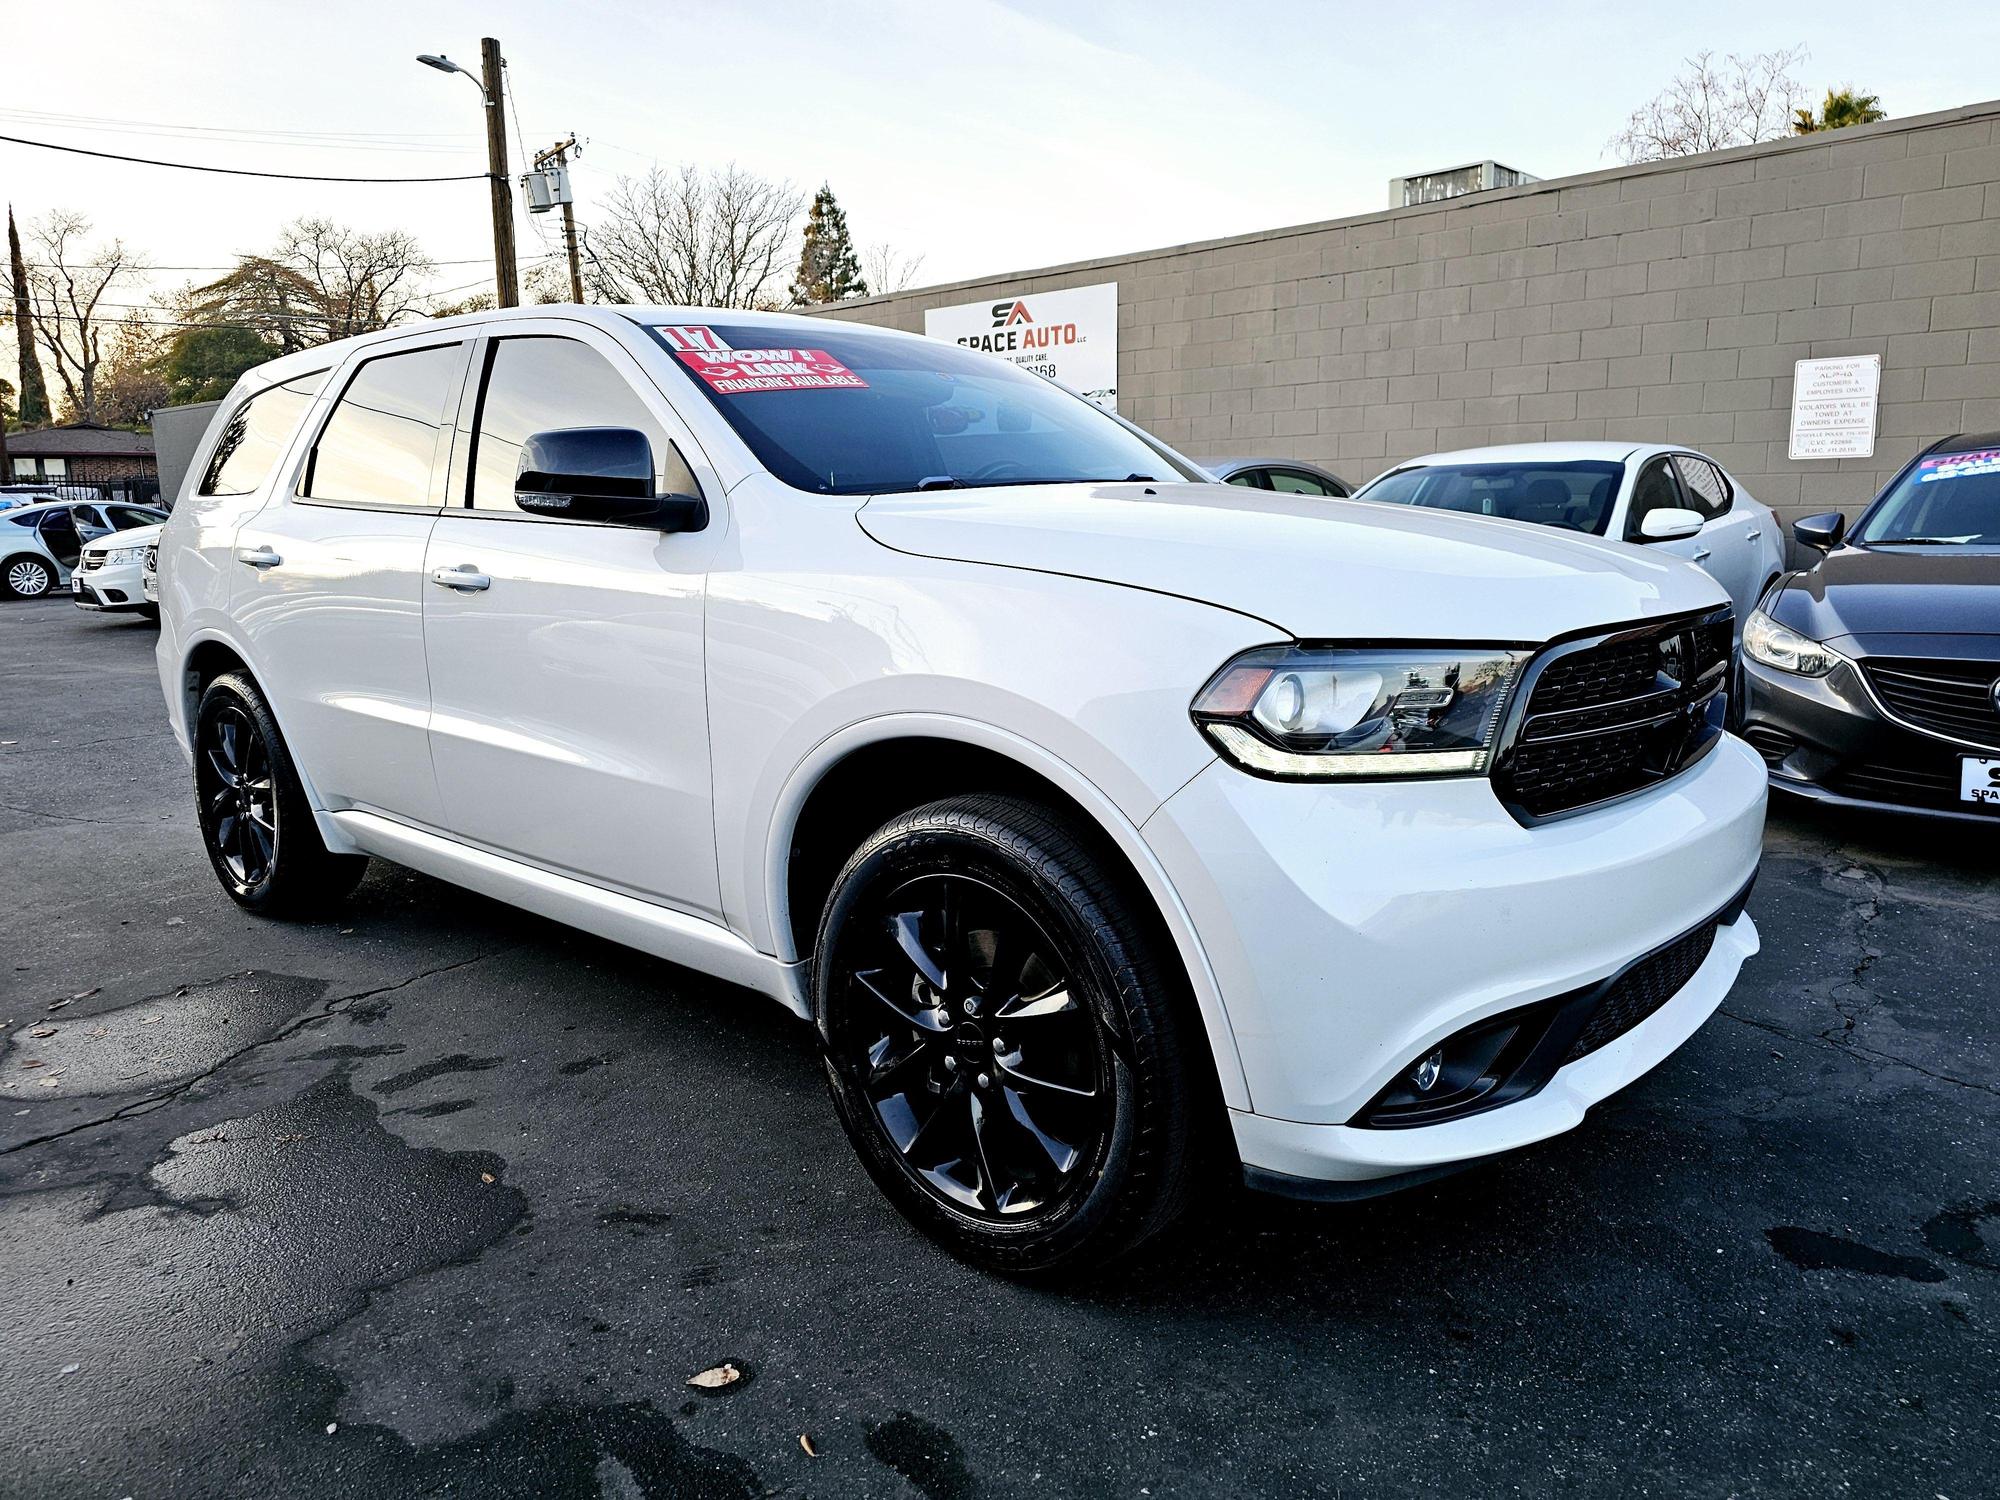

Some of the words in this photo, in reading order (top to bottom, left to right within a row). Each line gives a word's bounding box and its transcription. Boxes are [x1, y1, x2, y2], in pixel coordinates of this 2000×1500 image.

[663, 326, 718, 350] 17
[1023, 323, 1076, 349] AUTO
[1015, 355, 1034, 363] QUALITY
[737, 362, 817, 377] LOOK
[712, 377, 791, 391] FINANCING
[791, 375, 864, 388] AVAILABLE
[1799, 403, 1837, 411] VIOLATORS
